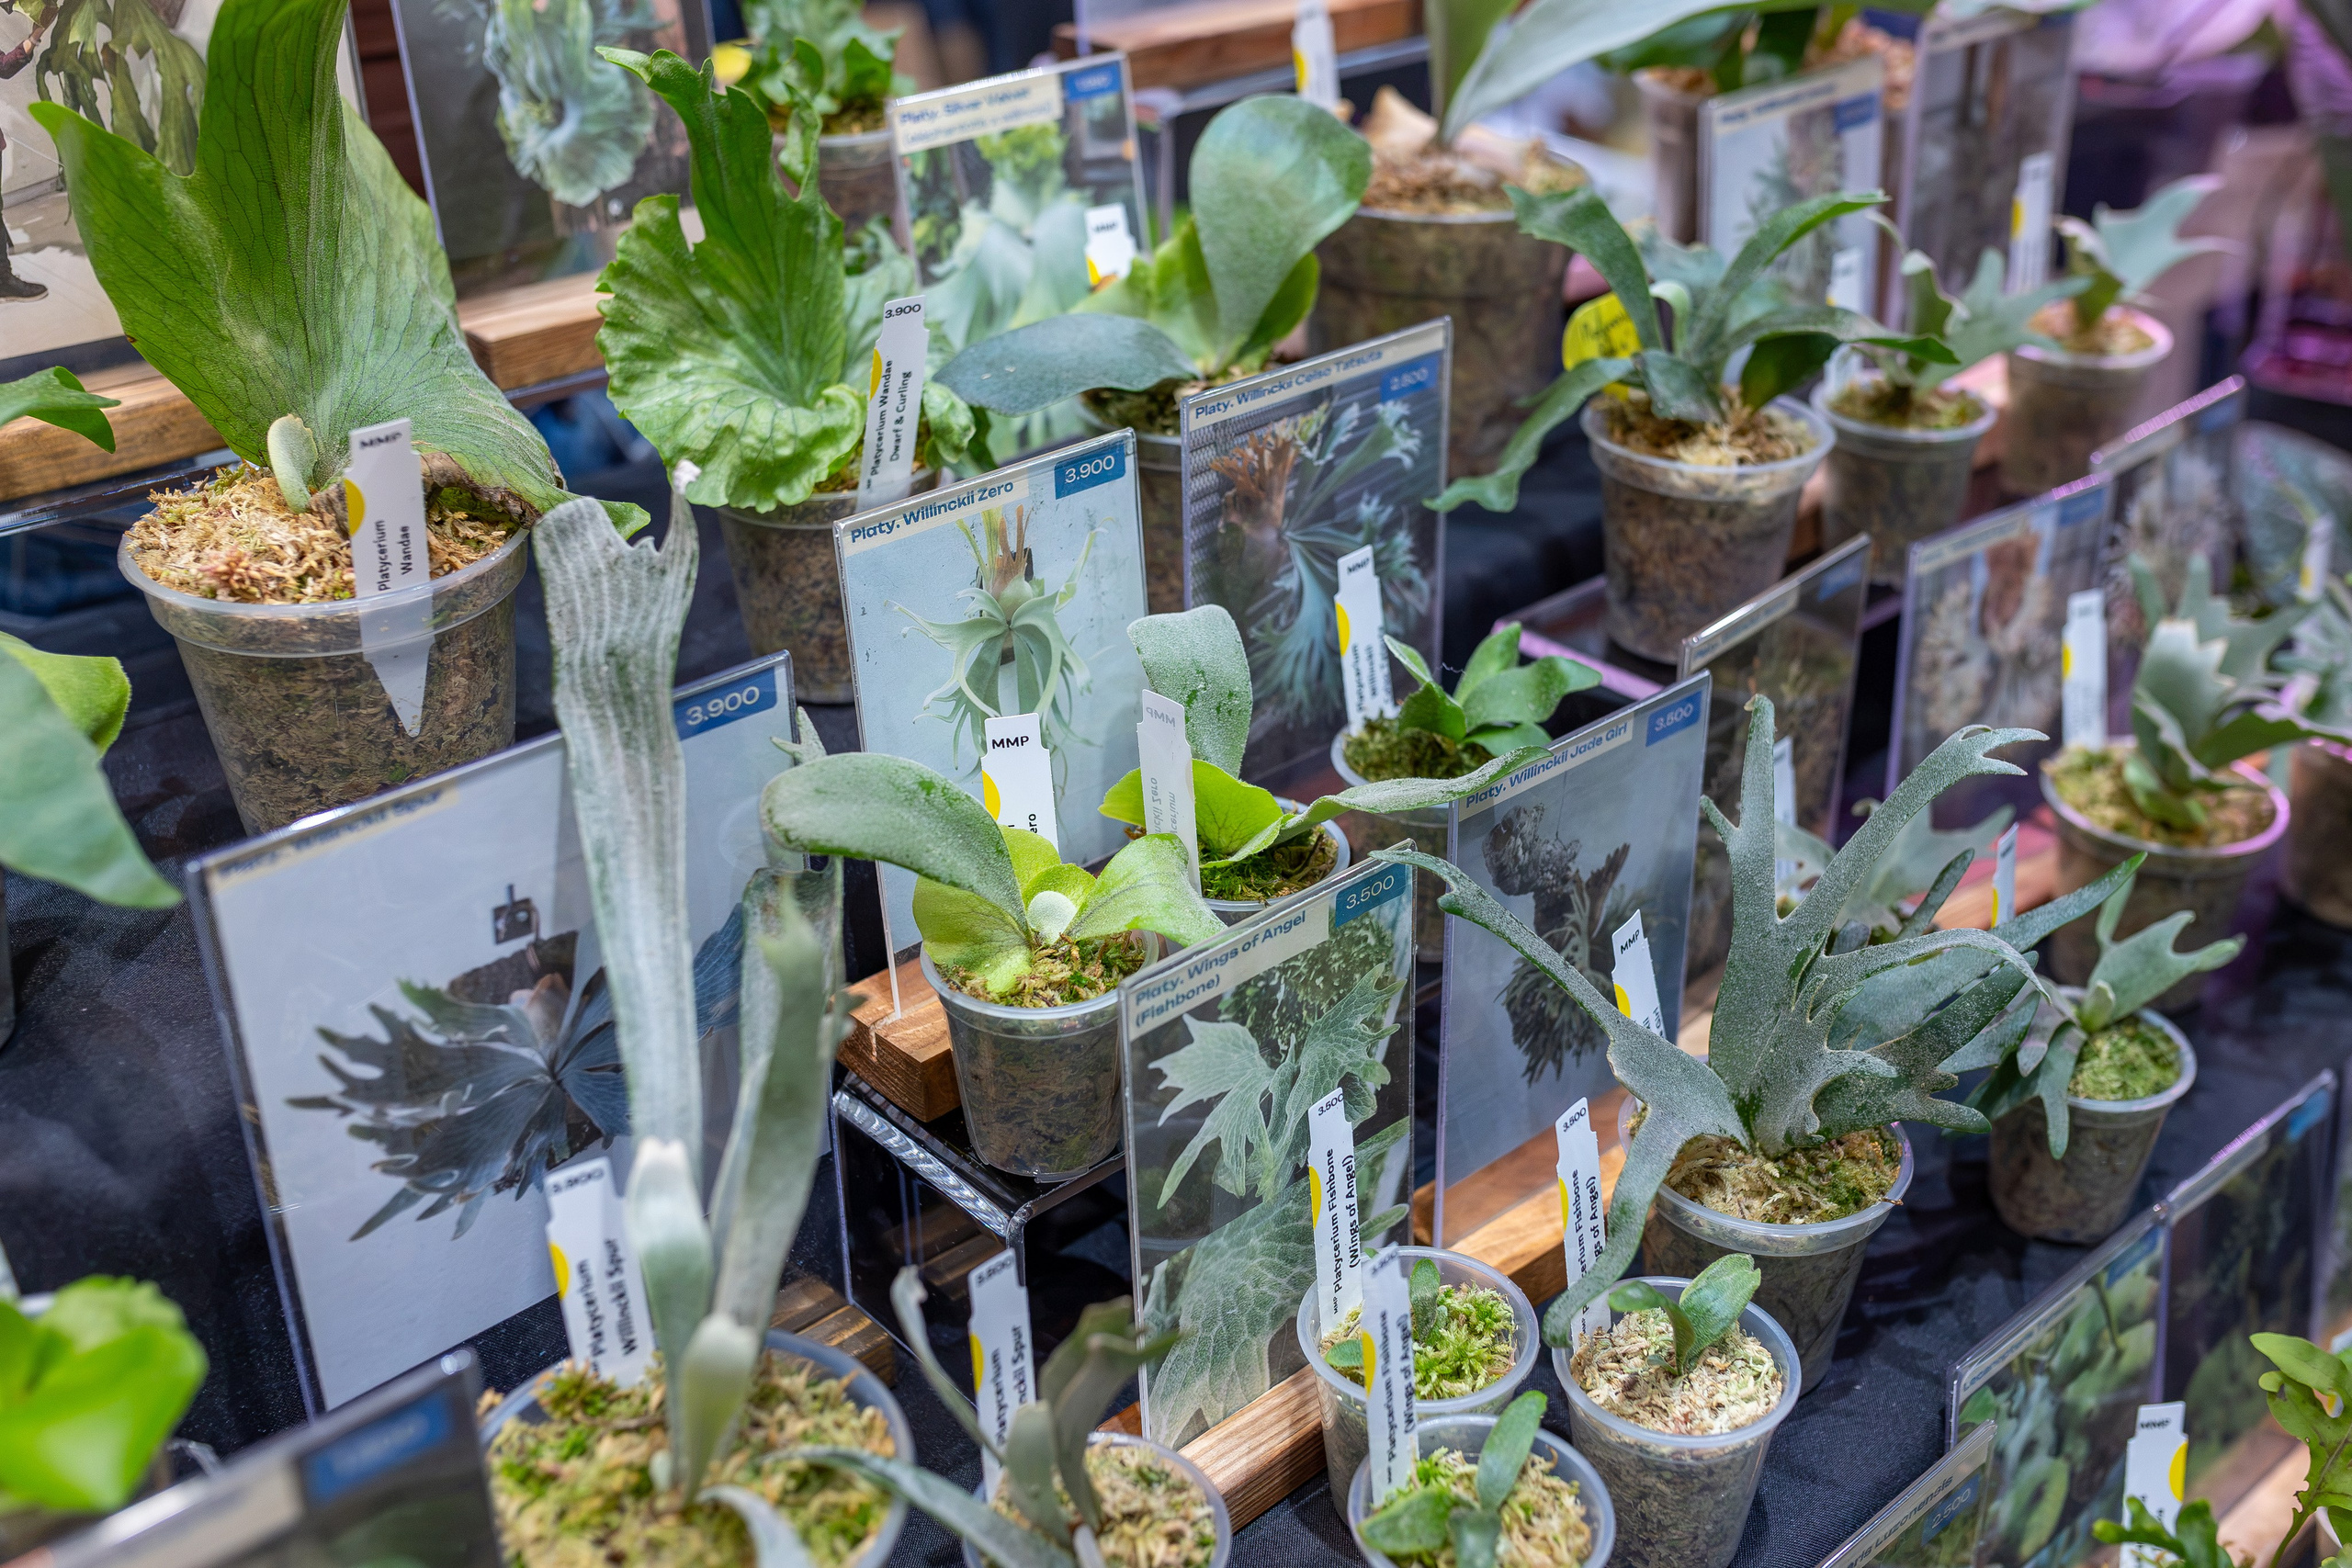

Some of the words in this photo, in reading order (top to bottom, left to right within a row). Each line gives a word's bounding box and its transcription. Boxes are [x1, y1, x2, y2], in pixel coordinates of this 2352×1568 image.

[885, 304, 922, 319] 3.900
[896, 371, 912, 413] Curling
[1194, 401, 1234, 419] Platy.
[871, 410, 887, 476] Platycerium
[879, 360, 893, 409] Wandae
[895, 415, 904, 425] &
[889, 425, 904, 462] Dwarf
[1064, 455, 1114, 484] 3.900
[851, 519, 900, 543] Platy.
[903, 489, 975, 525] Willinckii
[978, 481, 1014, 501] Zero
[373, 520, 392, 592] Platycerium
[397, 525, 413, 575] Wandae
[685, 685, 760, 726] 3.900
[991, 736, 1030, 750] MMP
[1465, 785, 1507, 808] Platy.
[1510, 751, 1568, 787] Willinckii
[1570, 737, 1603, 759] Jade
[1606, 722, 1628, 741] Girl
[1028, 813, 1038, 834] ero
[1346, 874, 1396, 909] 3.500
[1136, 977, 1184, 1007] Platy.
[1187, 946, 1239, 980] Wings
[1242, 933, 1260, 953] of
[1261, 910, 1306, 944] Angel
[1620, 929, 1640, 954] MMP
[1136, 974, 1220, 1028] (Fishbone)
[1317, 1093, 1344, 1116] 3.500
[1562, 1107, 1588, 1133] 3.500
[1326, 1148, 1338, 1213] Fishbone
[1341, 1154, 1355, 1201] Angel)
[1345, 1202, 1356, 1216] of
[1571, 1168, 1584, 1234] Fishbone
[1586, 1176, 1599, 1222] Angel)
[1349, 1219, 1361, 1269] (Wings
[1589, 1223, 1601, 1239] of
[1329, 1213, 1343, 1294] Platycerium
[1012, 1325, 1026, 1365] Spur
[1400, 1366, 1412, 1380] of
[1385, 1378, 1397, 1463] Platycerium
[1874, 1475, 1954, 1548] Luzonensis
[1931, 1487, 1972, 1529] 2.500
